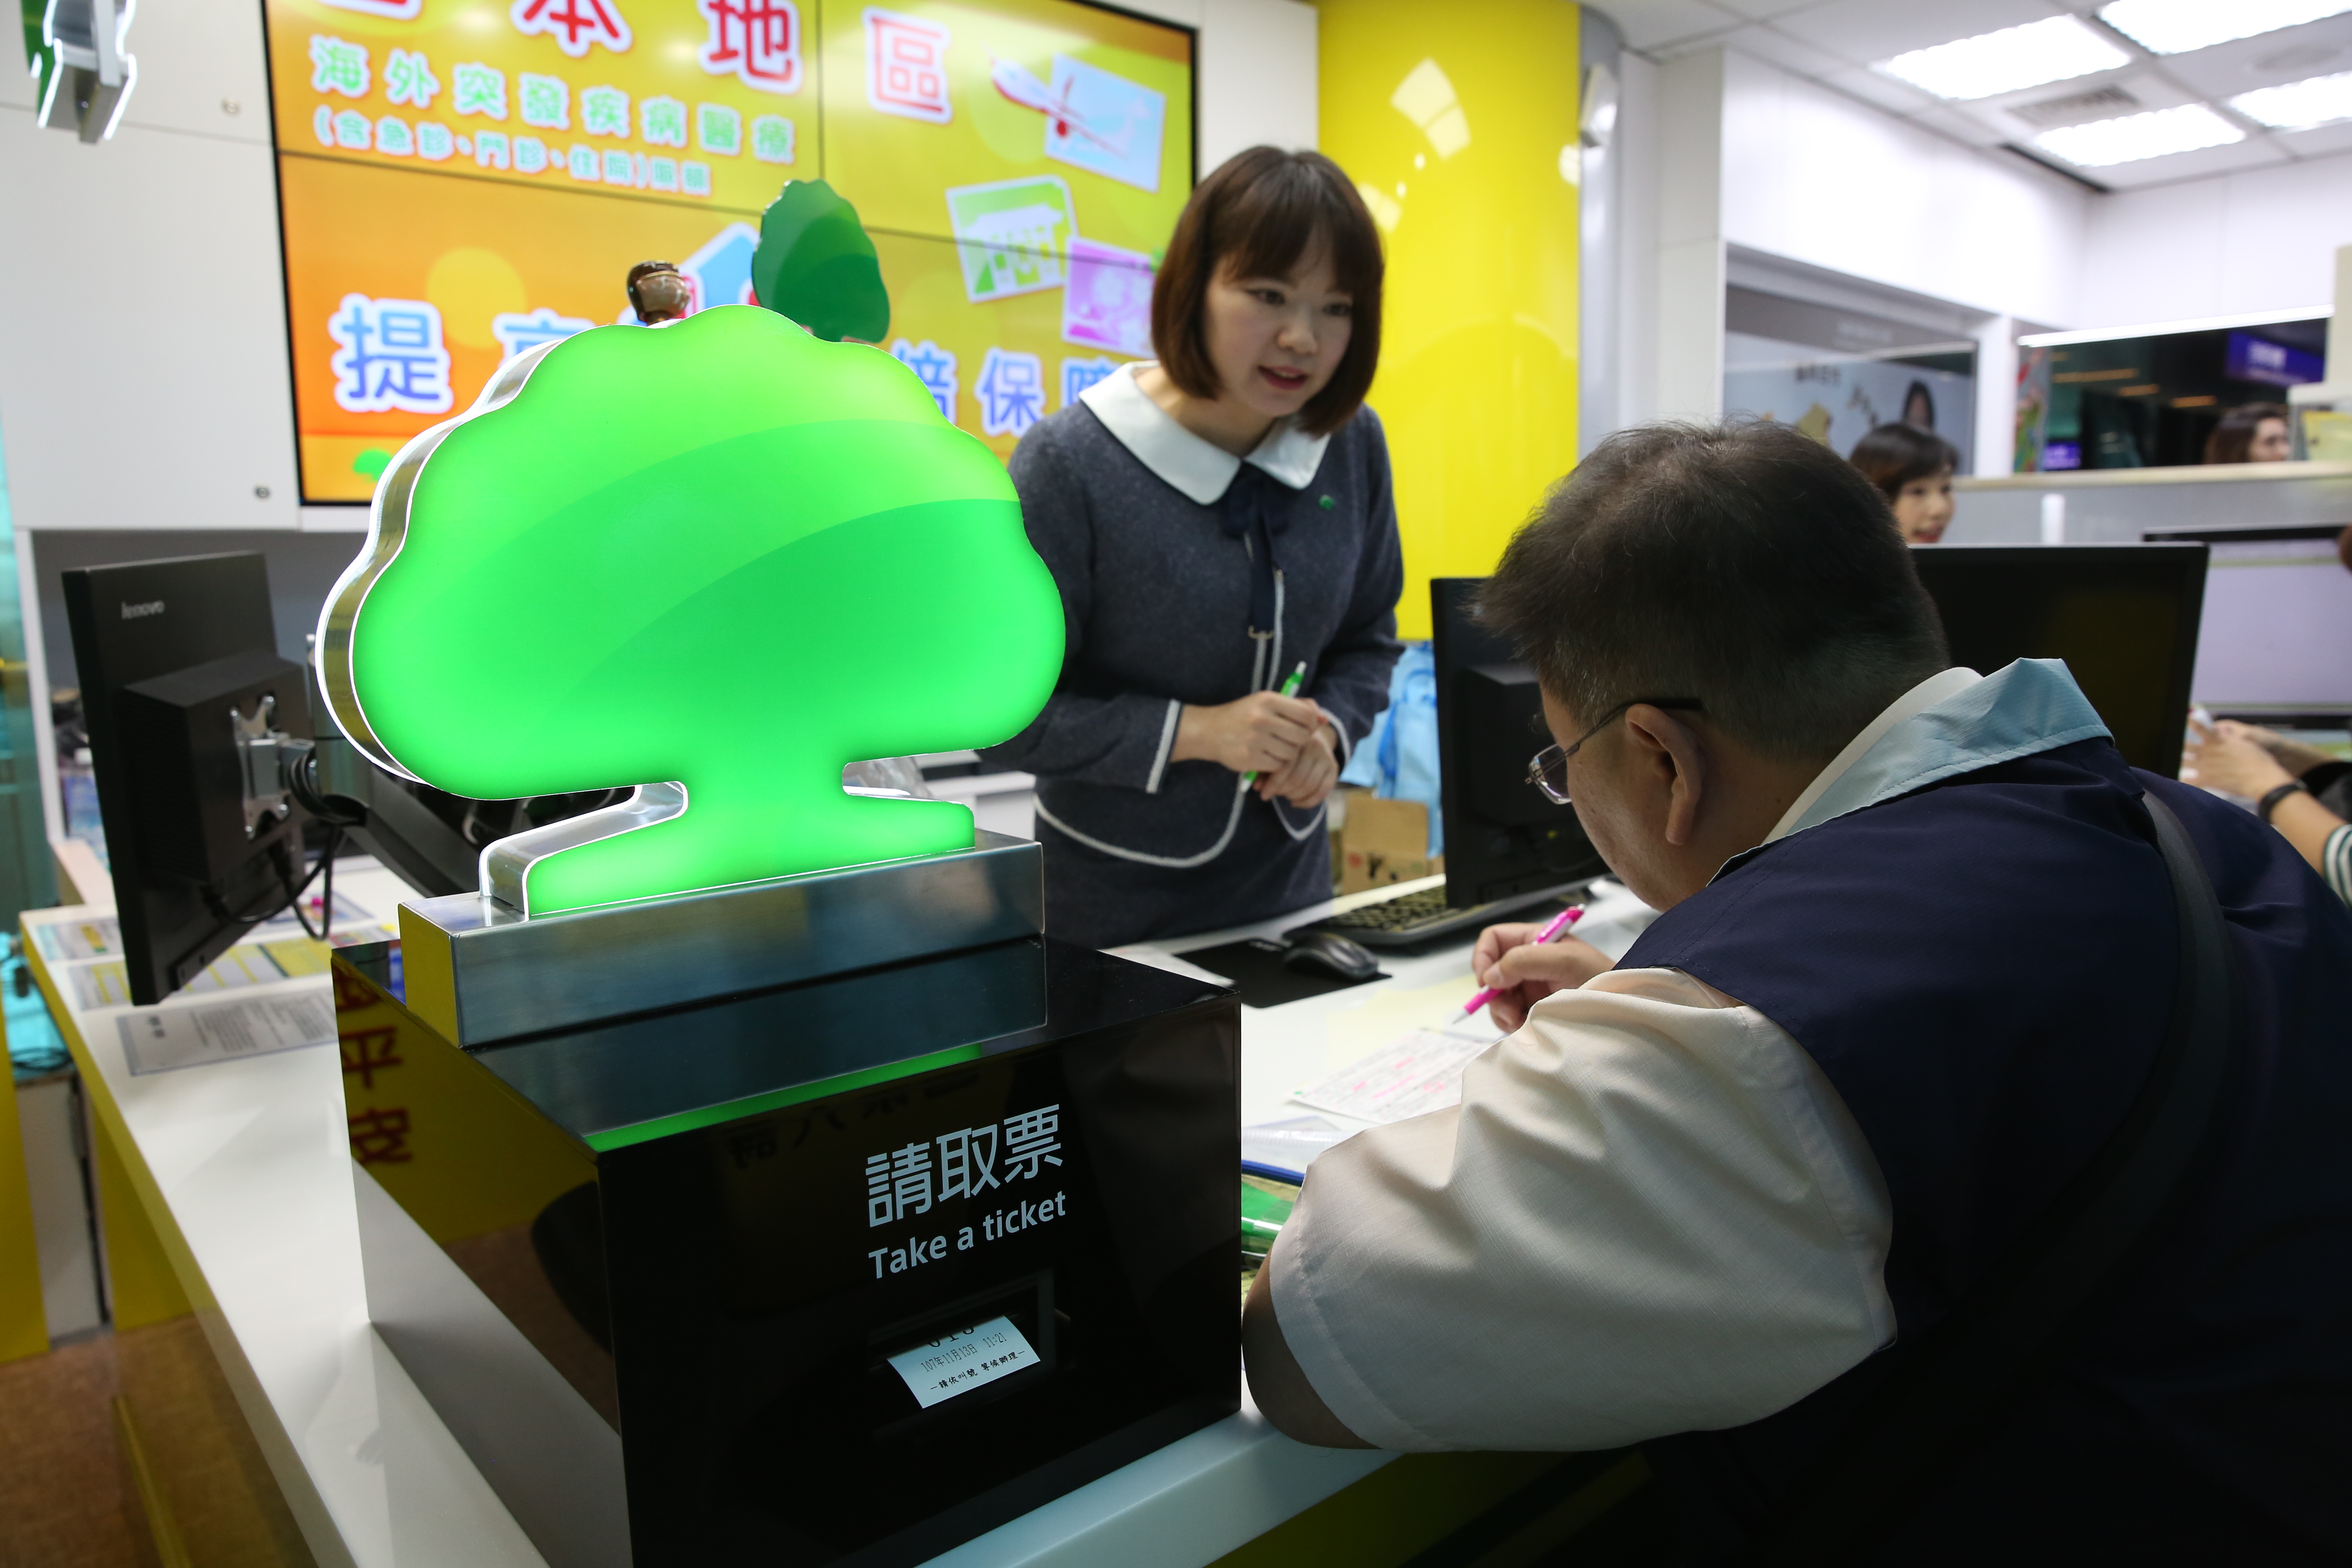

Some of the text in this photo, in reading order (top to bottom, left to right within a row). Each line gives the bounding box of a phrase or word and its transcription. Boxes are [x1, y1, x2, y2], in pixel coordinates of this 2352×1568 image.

[121, 600, 165, 620] lenovo
[865, 1104, 1063, 1228] 請取票
[868, 1190, 1066, 1279] Take a ticket
[921, 1343, 978, 1372] 107年11月13日
[982, 1332, 1007, 1348] 11:21
